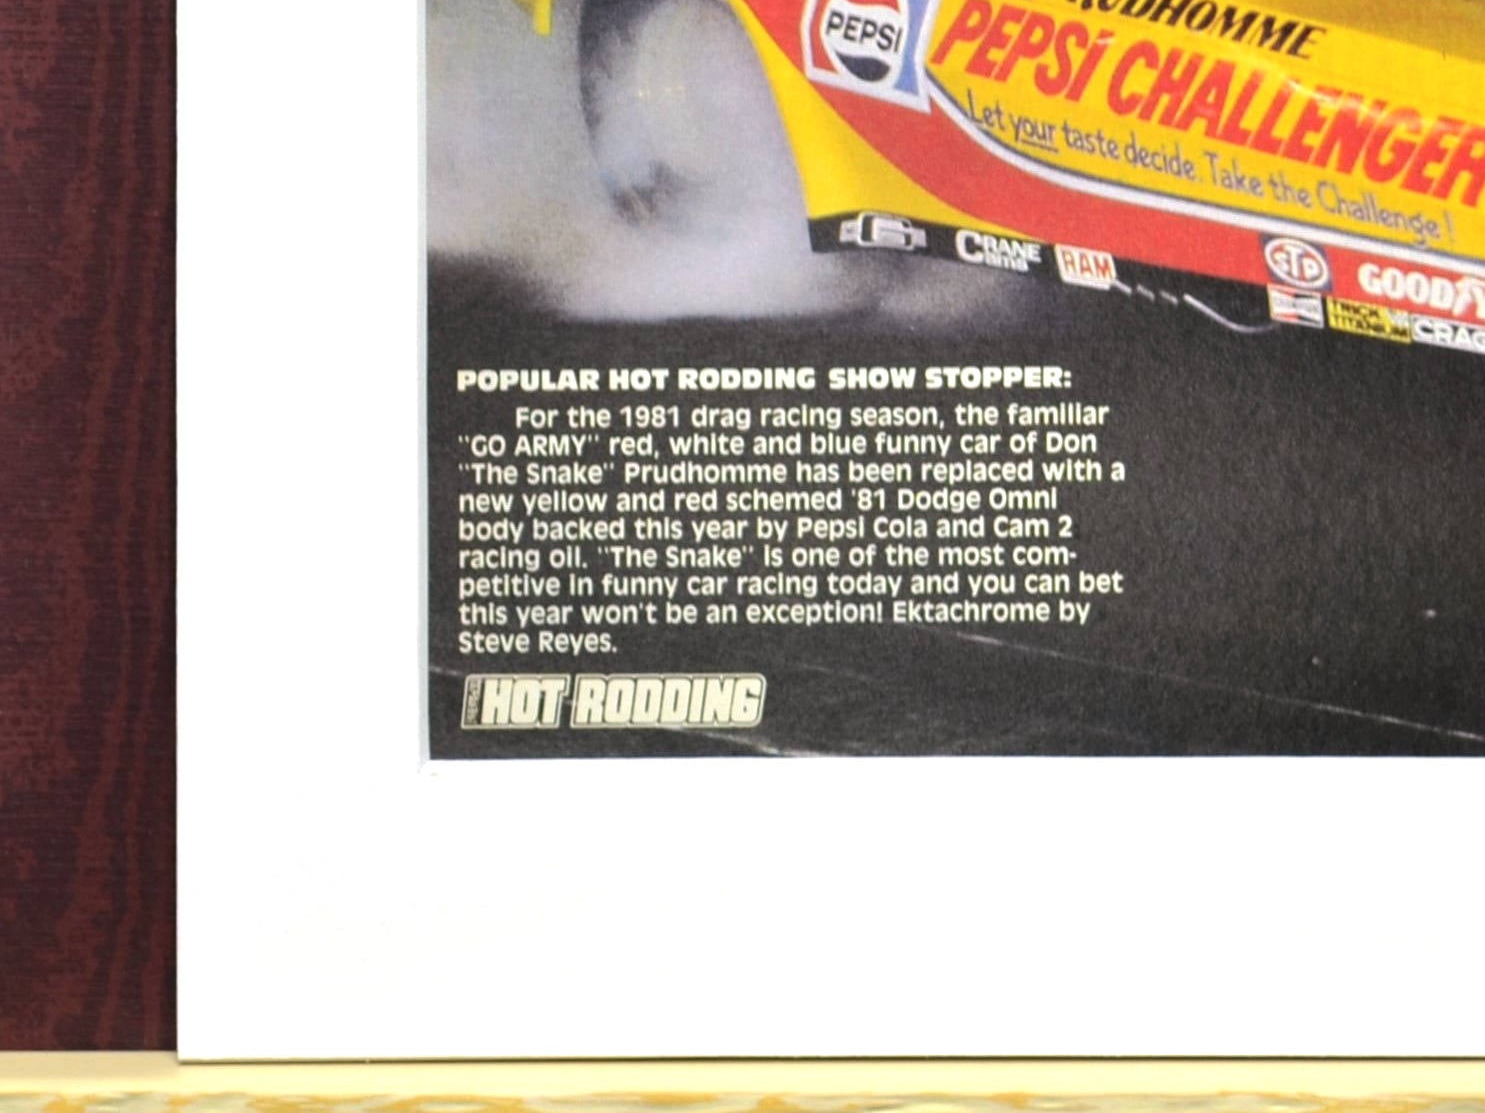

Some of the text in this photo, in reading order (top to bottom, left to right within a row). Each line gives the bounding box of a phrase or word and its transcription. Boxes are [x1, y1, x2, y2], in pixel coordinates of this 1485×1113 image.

[825, 9, 904, 54] PEPSI
[966, 88, 1006, 130] Let
[1012, 115, 1058, 153] your
[1063, 118, 1121, 159] taste
[1204, 150, 1264, 197] Take
[1268, 169, 1312, 208] the
[955, 229, 1042, 264] CRANE
[1062, 250, 1114, 281] RAM
[1272, 244, 1320, 281] STP
[457, 365, 1071, 391] POPULAR HOT RODDING SHOW STOPPER:
[516, 401, 1109, 431] For the 1981 drag racing season, the familiar
[459, 429, 1097, 459] "GO ARMY" red, white and blue funny car of Don
[459, 457, 1125, 485] "The Snake" Prudhomme has been replaced with a
[459, 485, 1057, 515] new yellow and red schemed '81 Dodge Omni
[459, 514, 1072, 544] body backed this year by Pepsi Cola and Cam 2
[460, 542, 1076, 572] racing oil. "The Snake" is one of the most com-
[459, 570, 1123, 600] petitive in funny car racing today and you can bet
[459, 598, 1090, 628] this year won't be an exception! Ektachrome by
[459, 630, 617, 655] Steve Reyes.
[480, 677, 568, 725] HOT
[573, 676, 764, 725] RODDING
